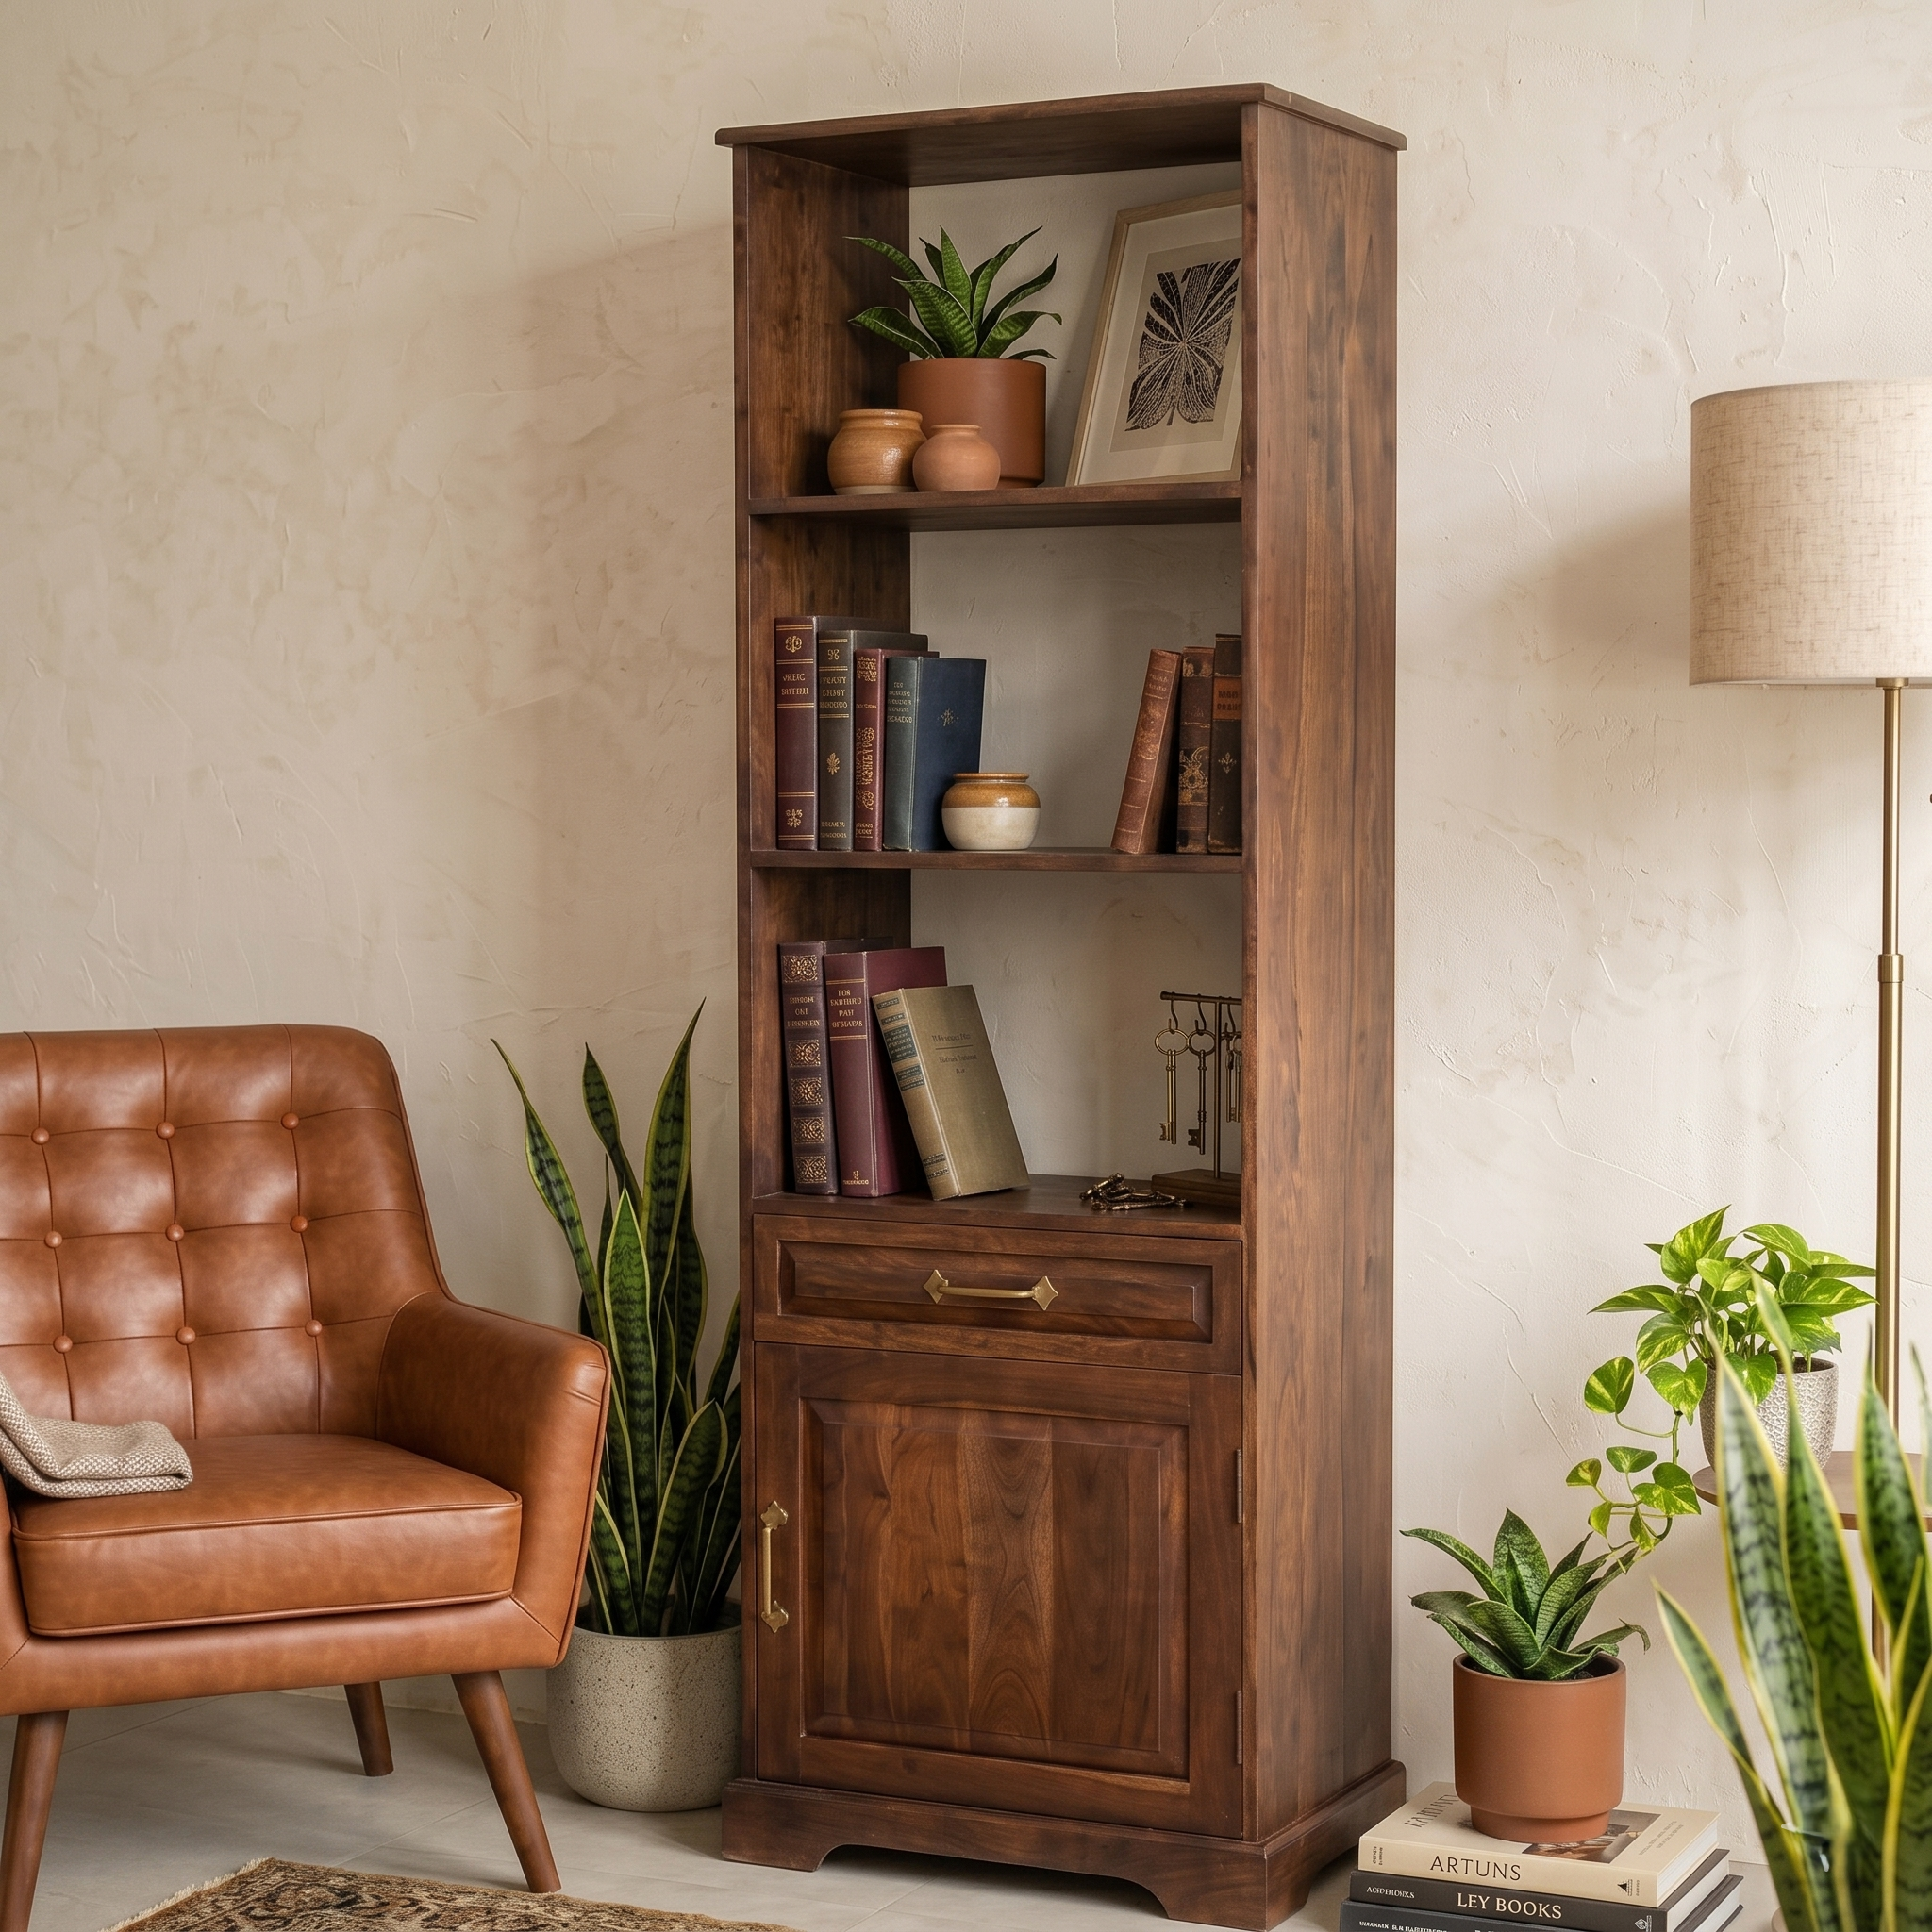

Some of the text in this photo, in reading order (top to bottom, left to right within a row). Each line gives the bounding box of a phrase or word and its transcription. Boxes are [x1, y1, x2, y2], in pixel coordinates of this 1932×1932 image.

[1429, 1855, 1521, 1881] ARTUNS
[1457, 1892, 1562, 1920] LEY BOOKS
